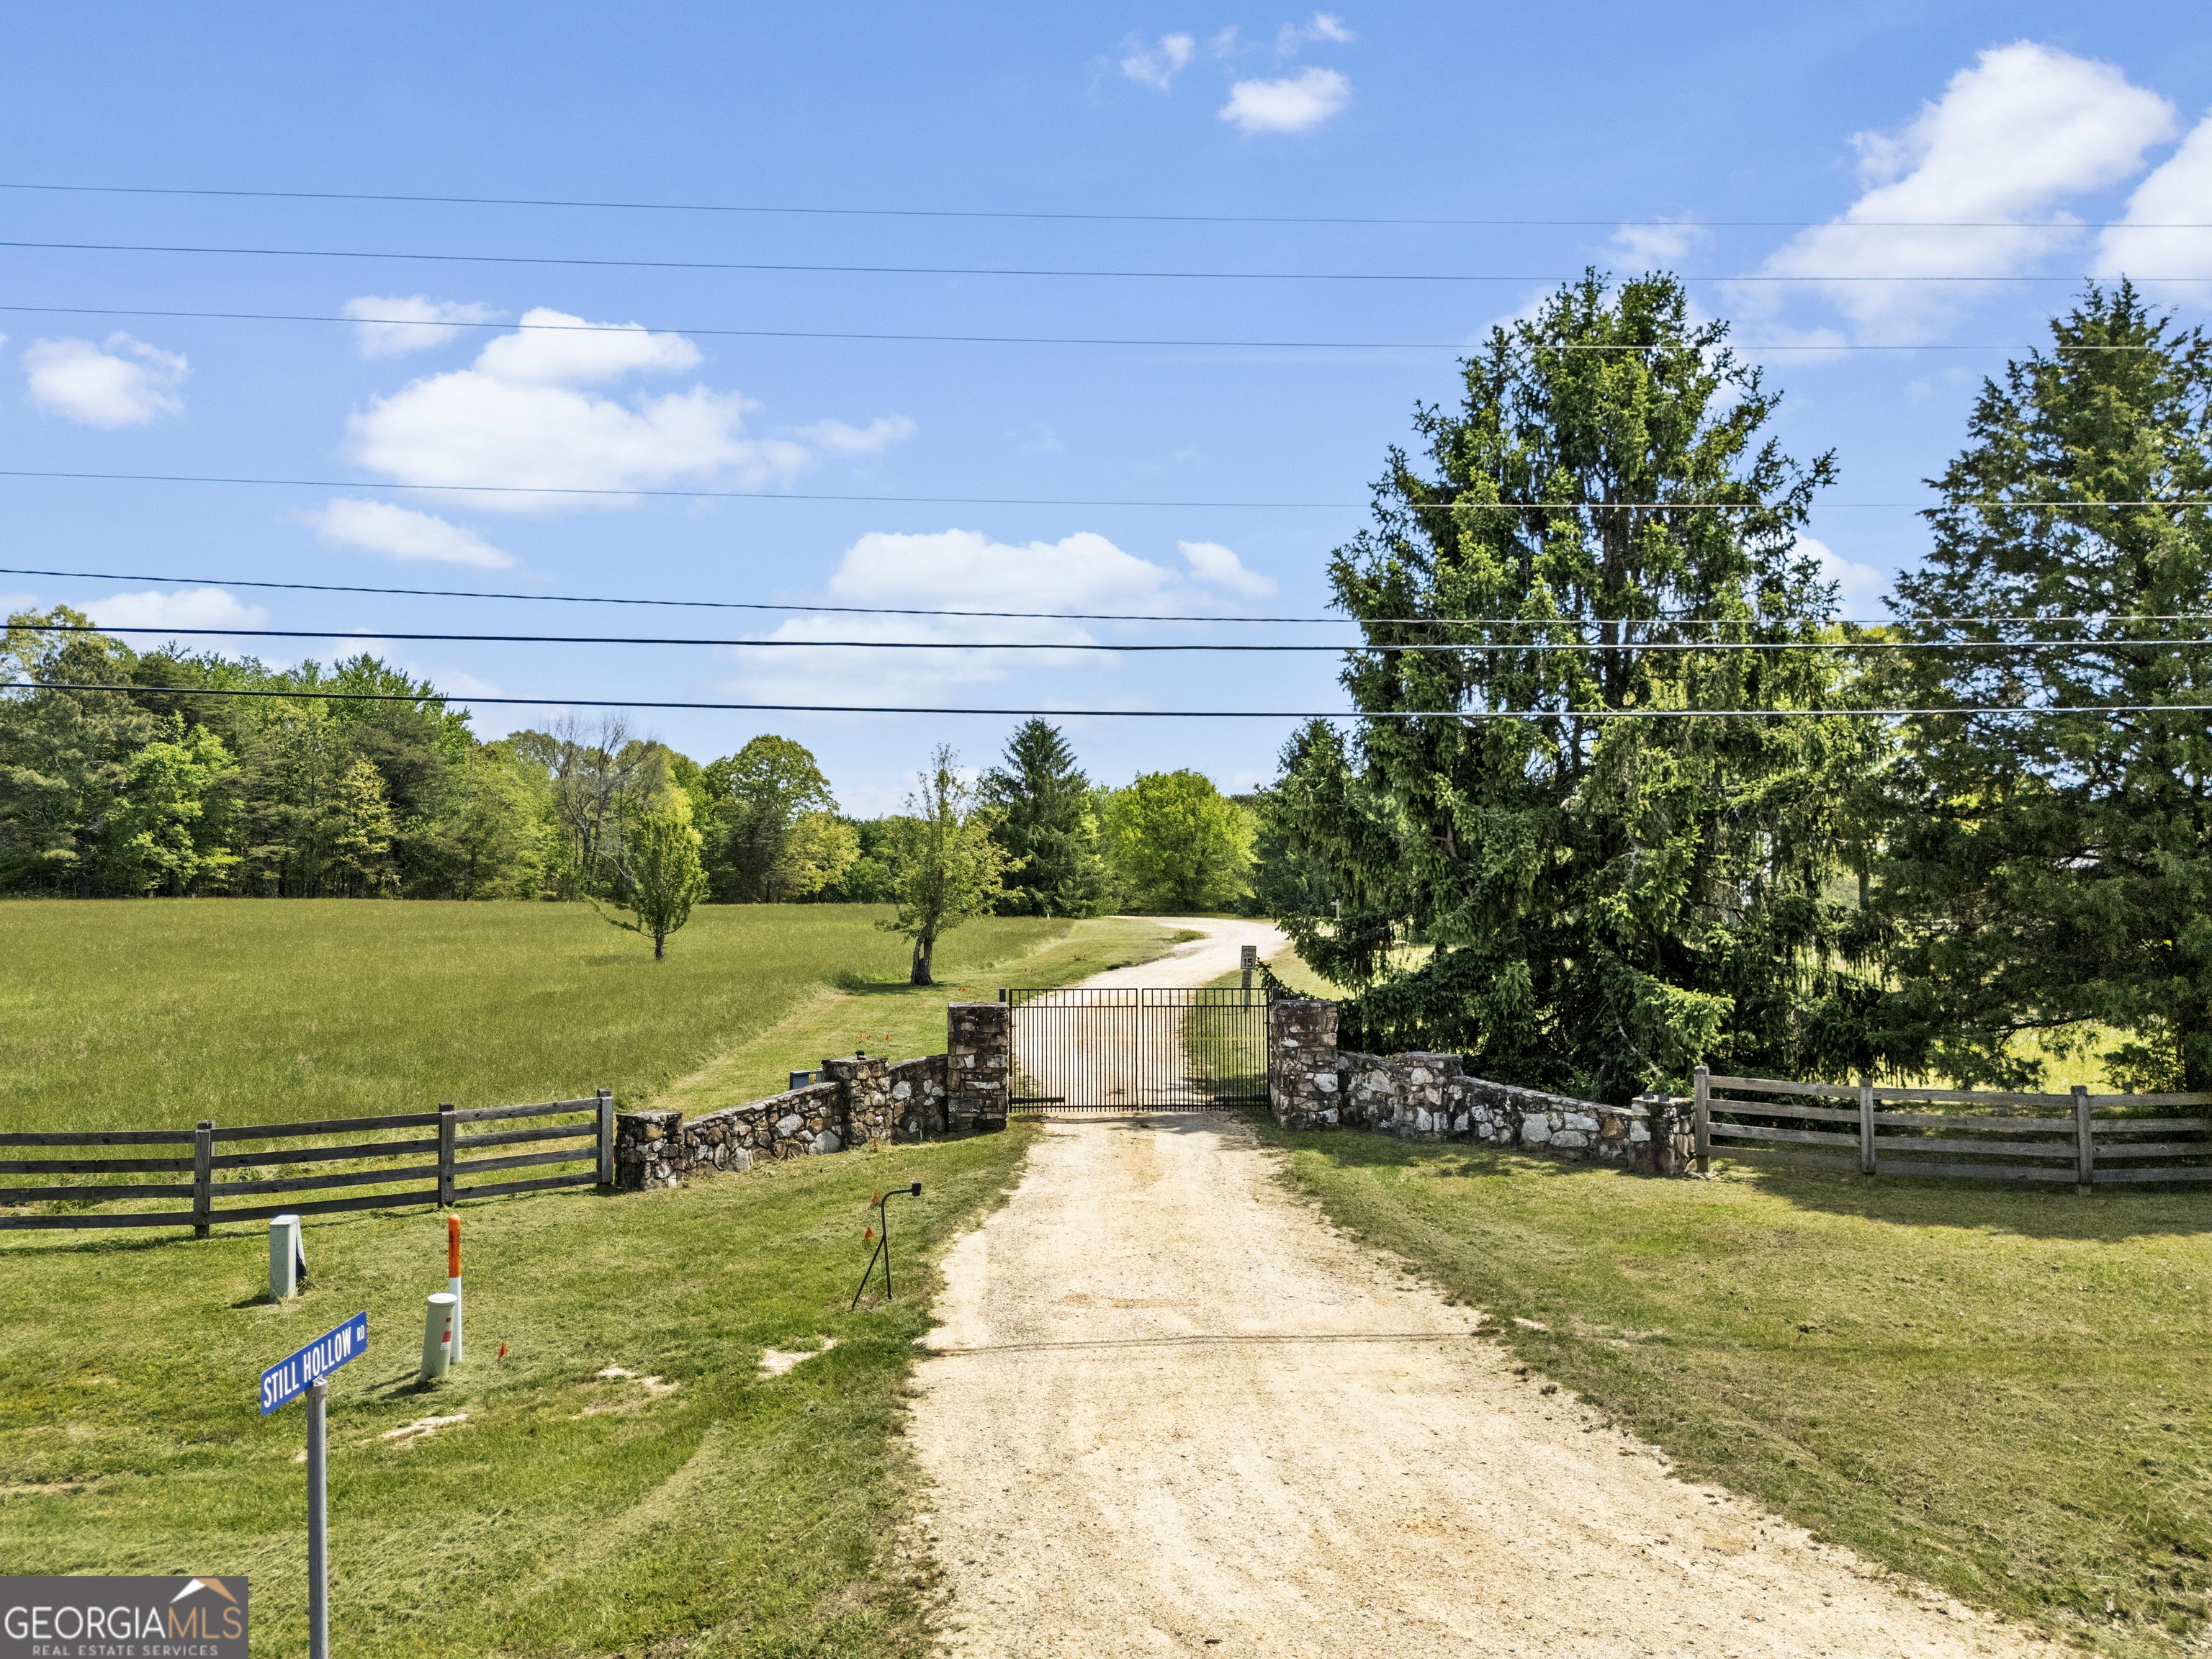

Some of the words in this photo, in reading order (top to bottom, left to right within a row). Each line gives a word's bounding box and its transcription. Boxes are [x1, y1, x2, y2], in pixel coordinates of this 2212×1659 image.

[1244, 958, 1253, 967] 15
[264, 1361, 300, 1408] STILL
[303, 1326, 351, 1383] HOLLOW
[356, 1324, 365, 1342] RD
